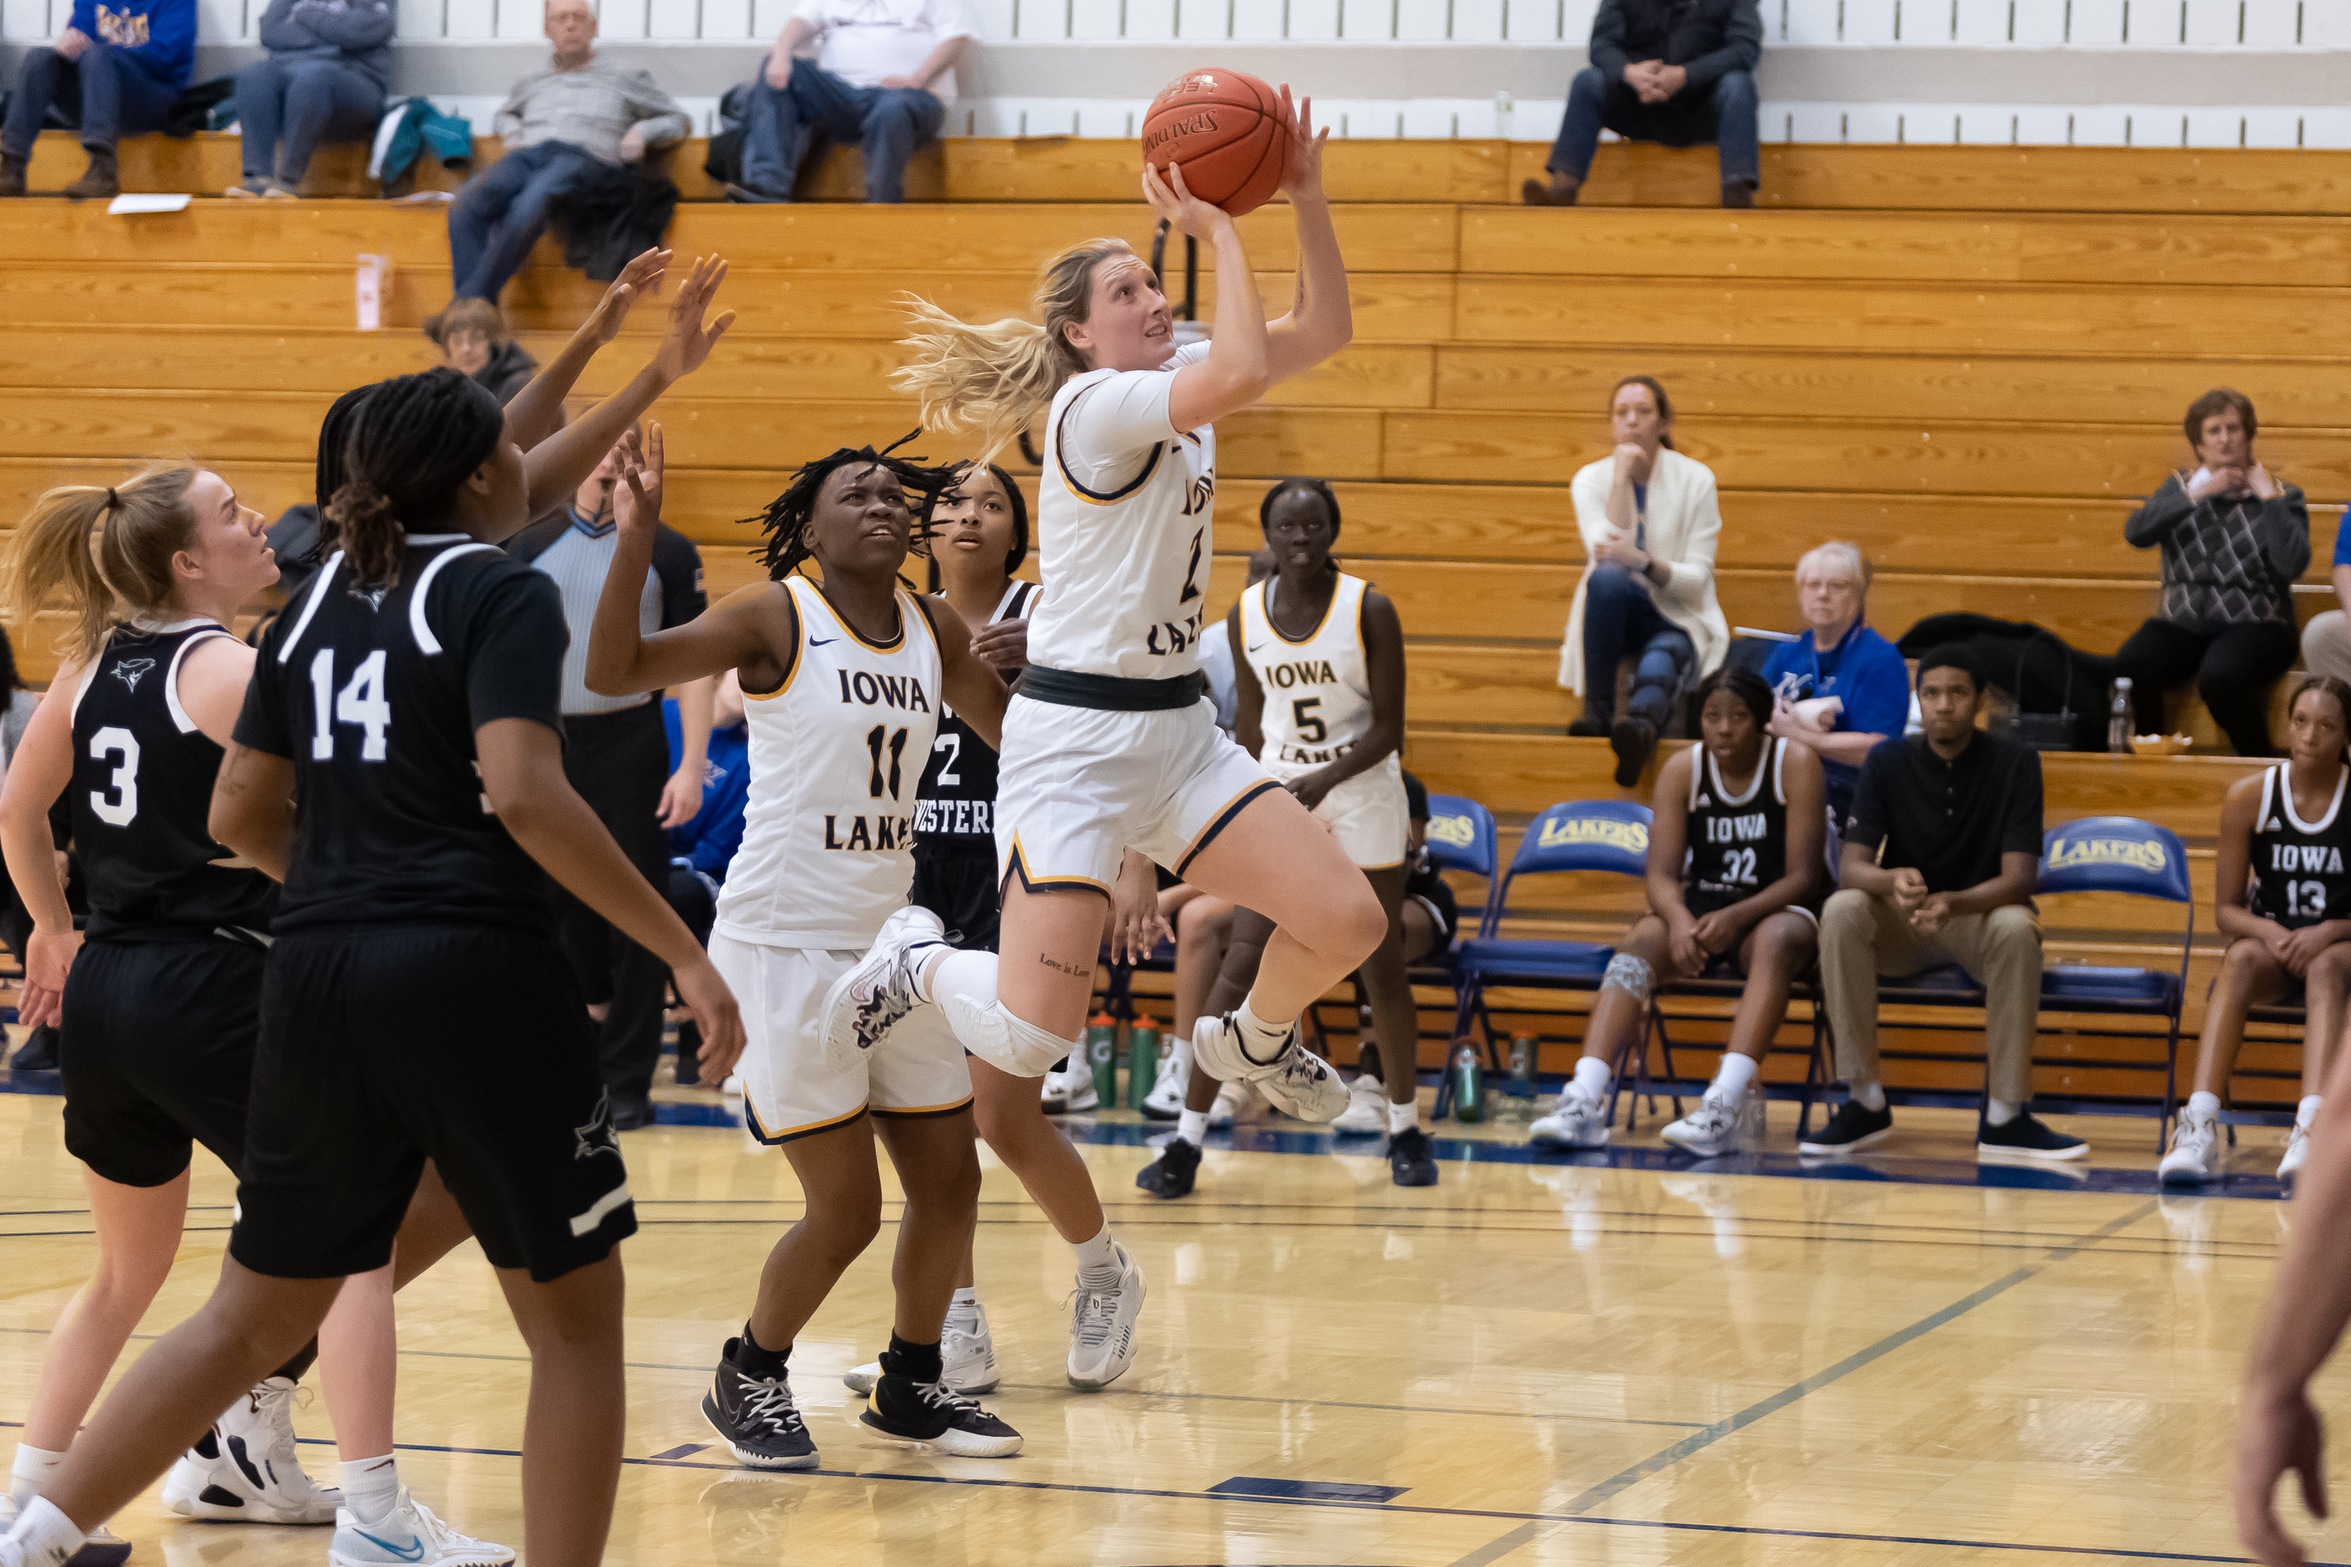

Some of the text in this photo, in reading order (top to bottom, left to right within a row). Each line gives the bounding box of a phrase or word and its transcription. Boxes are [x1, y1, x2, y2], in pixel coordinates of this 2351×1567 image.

[837, 669, 931, 715] IOWA
[1265, 660, 1338, 688] IOWA
[311, 648, 391, 762] 14
[1293, 697, 1327, 743] 5
[90, 726, 140, 827] 3
[867, 722, 910, 803] 11
[934, 733, 961, 786] 2
[1538, 817, 1649, 854] LAKERS
[1706, 812, 1767, 843] IOWA
[1721, 847, 1758, 885] 32
[2048, 838, 2166, 873] LAKERS
[2271, 843, 2344, 874] IOWA
[2286, 879, 2326, 918] 13
[1040, 952, 1062, 971] Love
[1063, 961, 1072, 974] is
